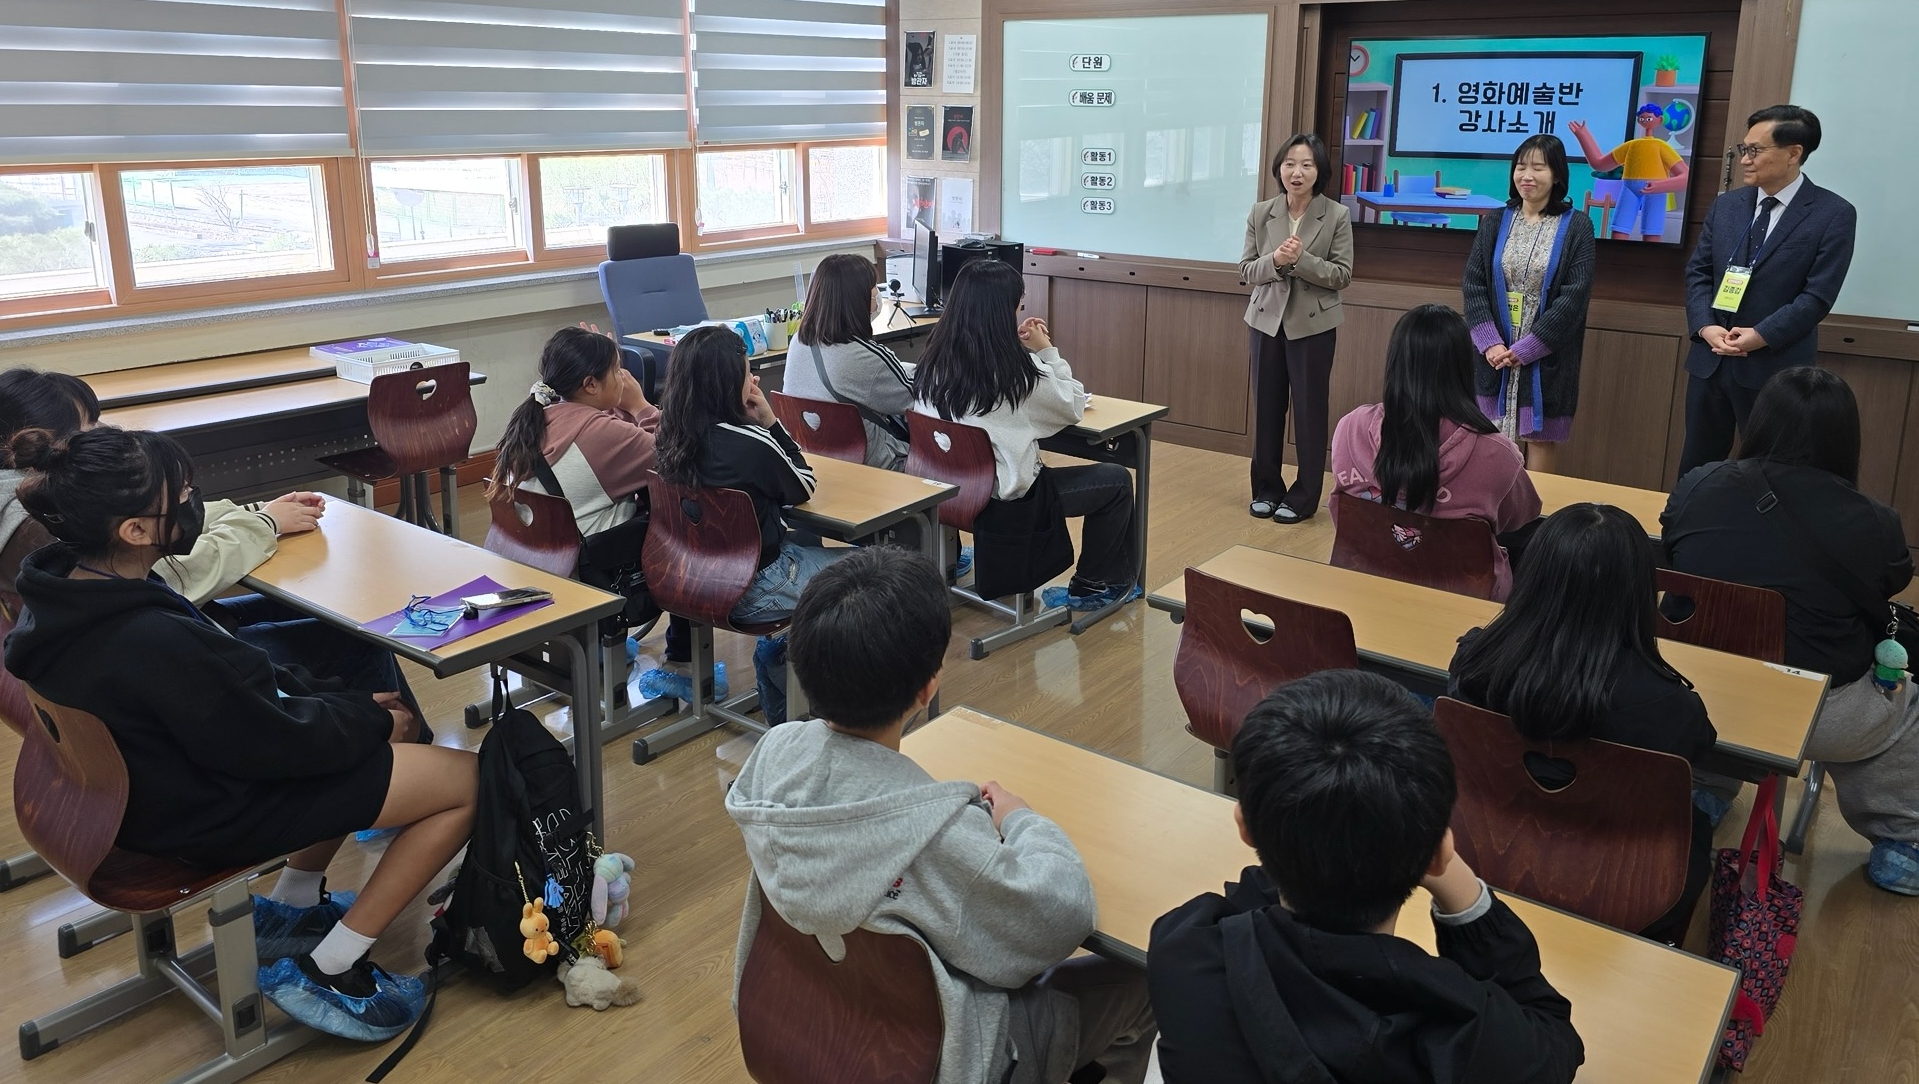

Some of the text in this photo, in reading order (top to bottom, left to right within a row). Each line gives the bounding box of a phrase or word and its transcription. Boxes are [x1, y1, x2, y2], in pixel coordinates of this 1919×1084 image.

[1082, 56, 1103, 69] 단원
[1079, 91, 1113, 104] 배움 문제
[1432, 81, 1584, 106] 1. 영화예술반
[1458, 110, 1556, 134] 강사소개
[1090, 151, 1112, 162] 활동1
[1090, 175, 1113, 187] 활동2
[1090, 200, 1112, 211] 활동3
